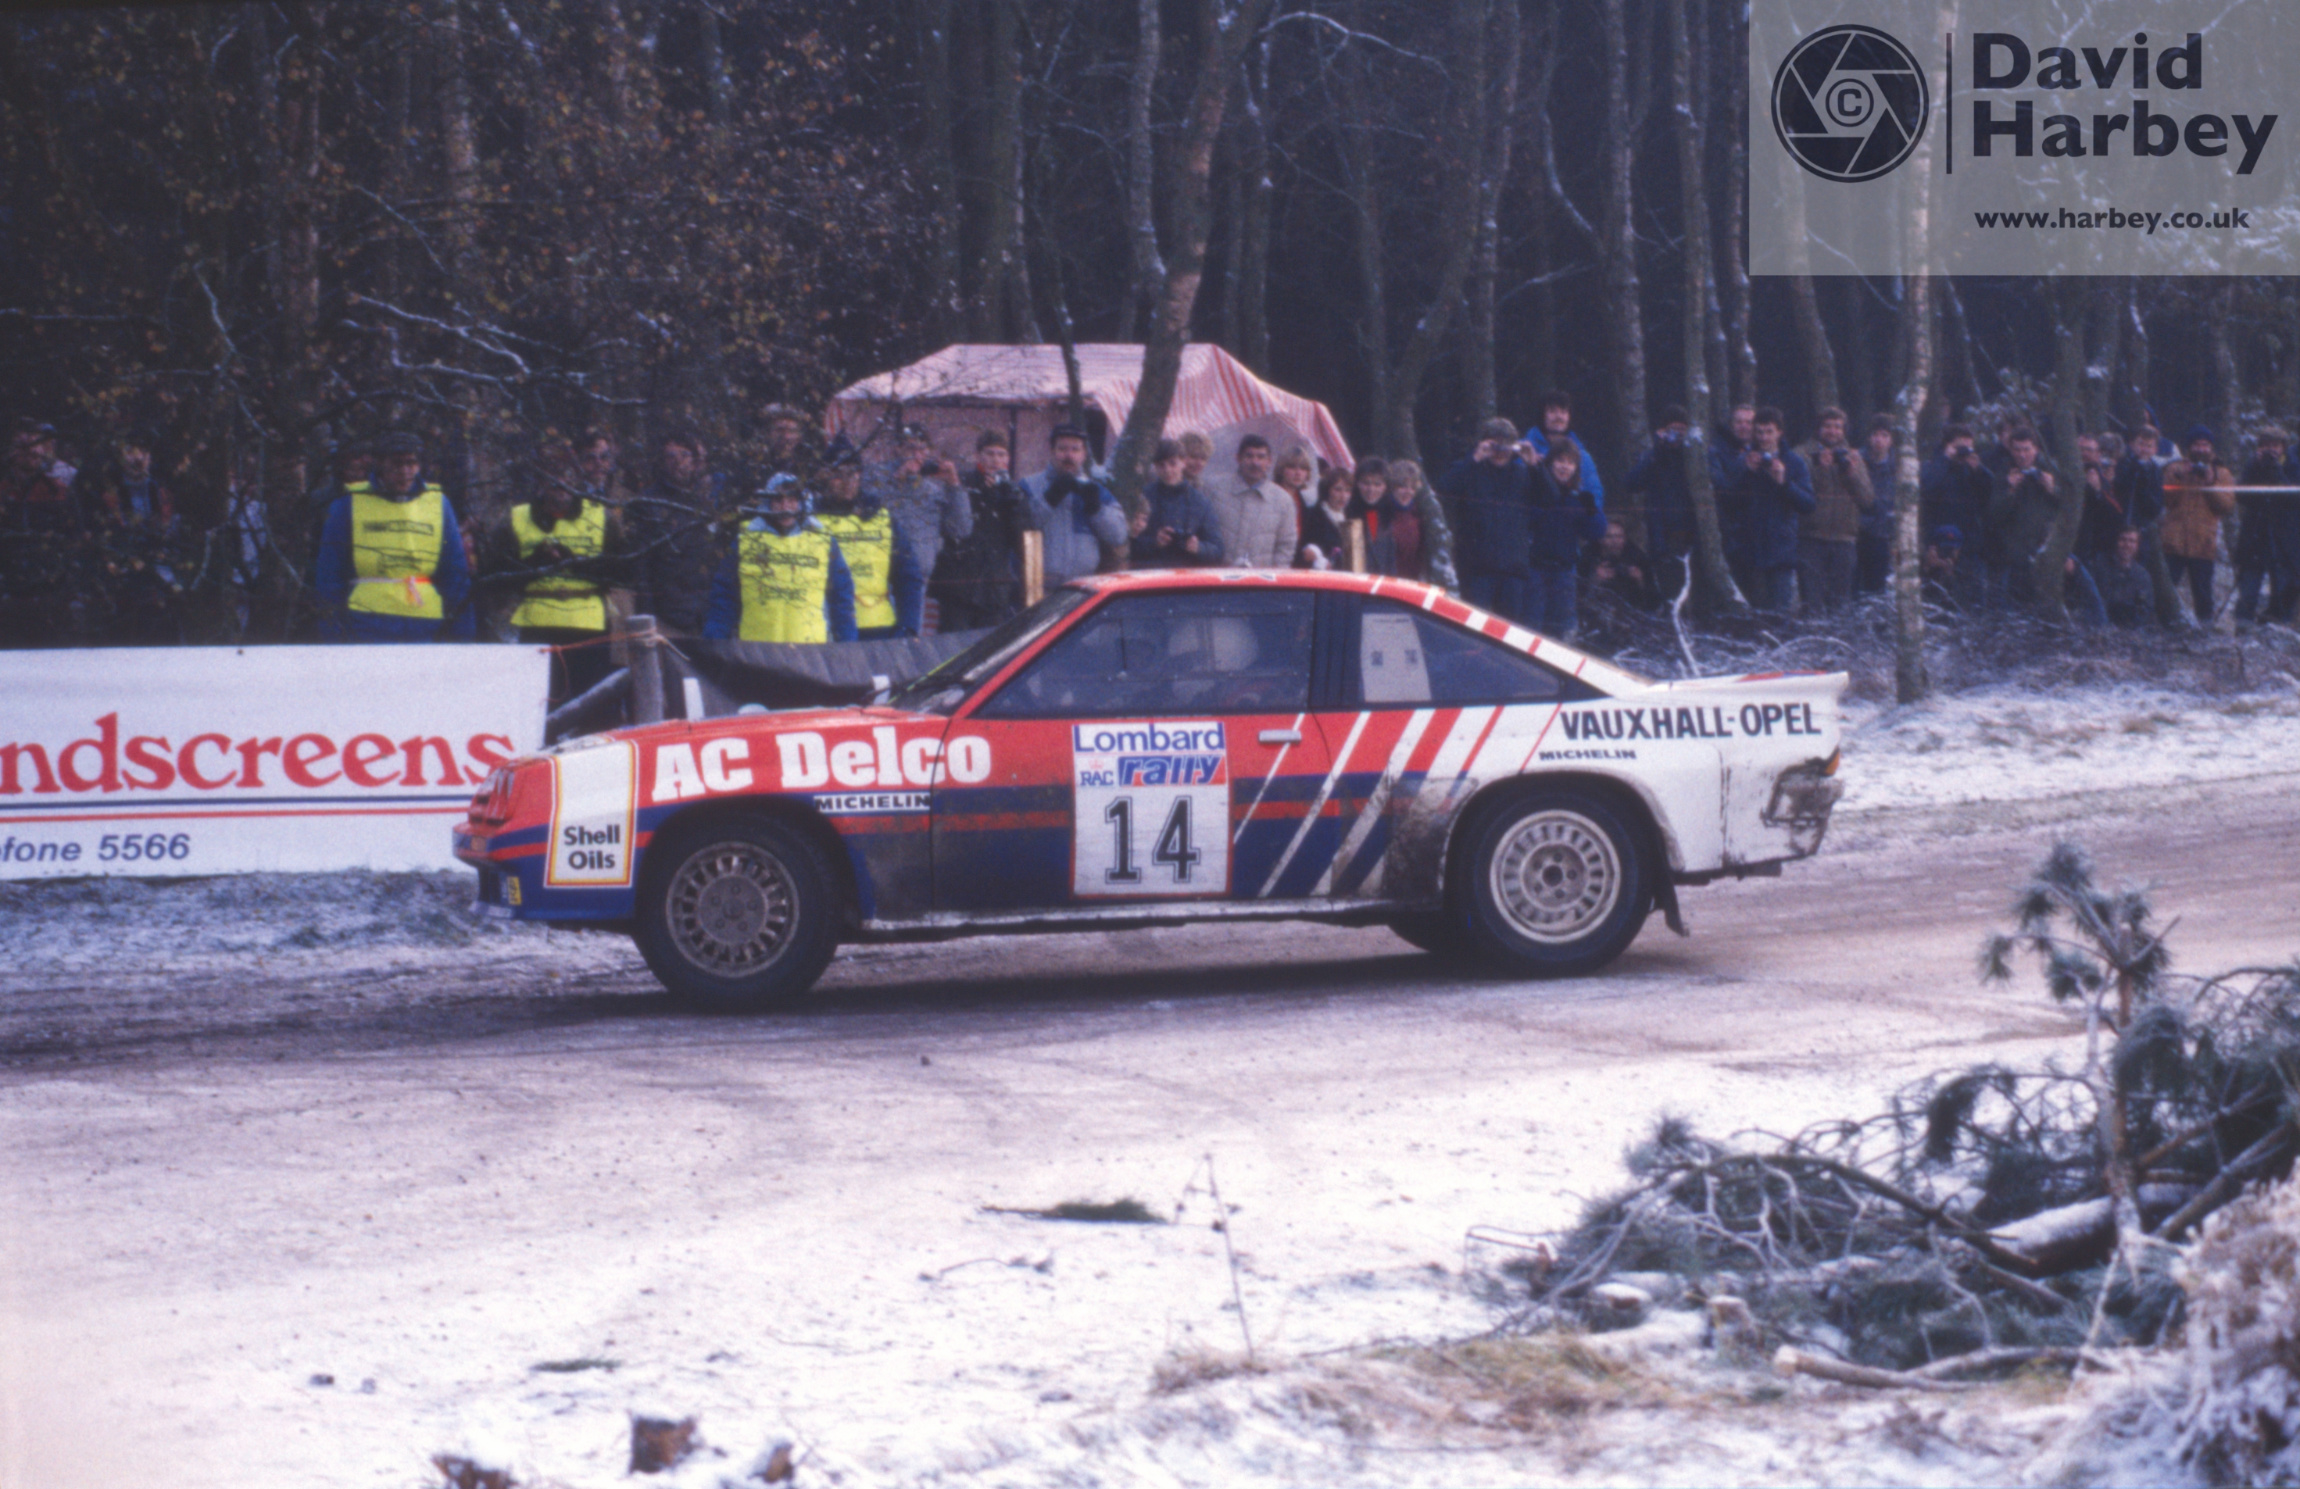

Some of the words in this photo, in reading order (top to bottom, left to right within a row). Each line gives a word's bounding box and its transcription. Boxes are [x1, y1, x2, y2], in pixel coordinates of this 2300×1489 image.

[1560, 703, 1821, 740] VAUXHALL-OPEL
[1074, 721, 1225, 753] Lombard
[652, 737, 753, 802] AC
[776, 725, 992, 788] Delco
[1538, 750, 1637, 761] MICHELIN
[1080, 770, 1114, 787] RAC
[1120, 755, 1222, 786] rally
[816, 794, 930, 811] MICHELIN
[0, 836, 81, 862] fone
[98, 833, 191, 861] 5566
[564, 824, 620, 846] Shell
[1104, 795, 1201, 885] 14
[568, 851, 615, 870] Oils
